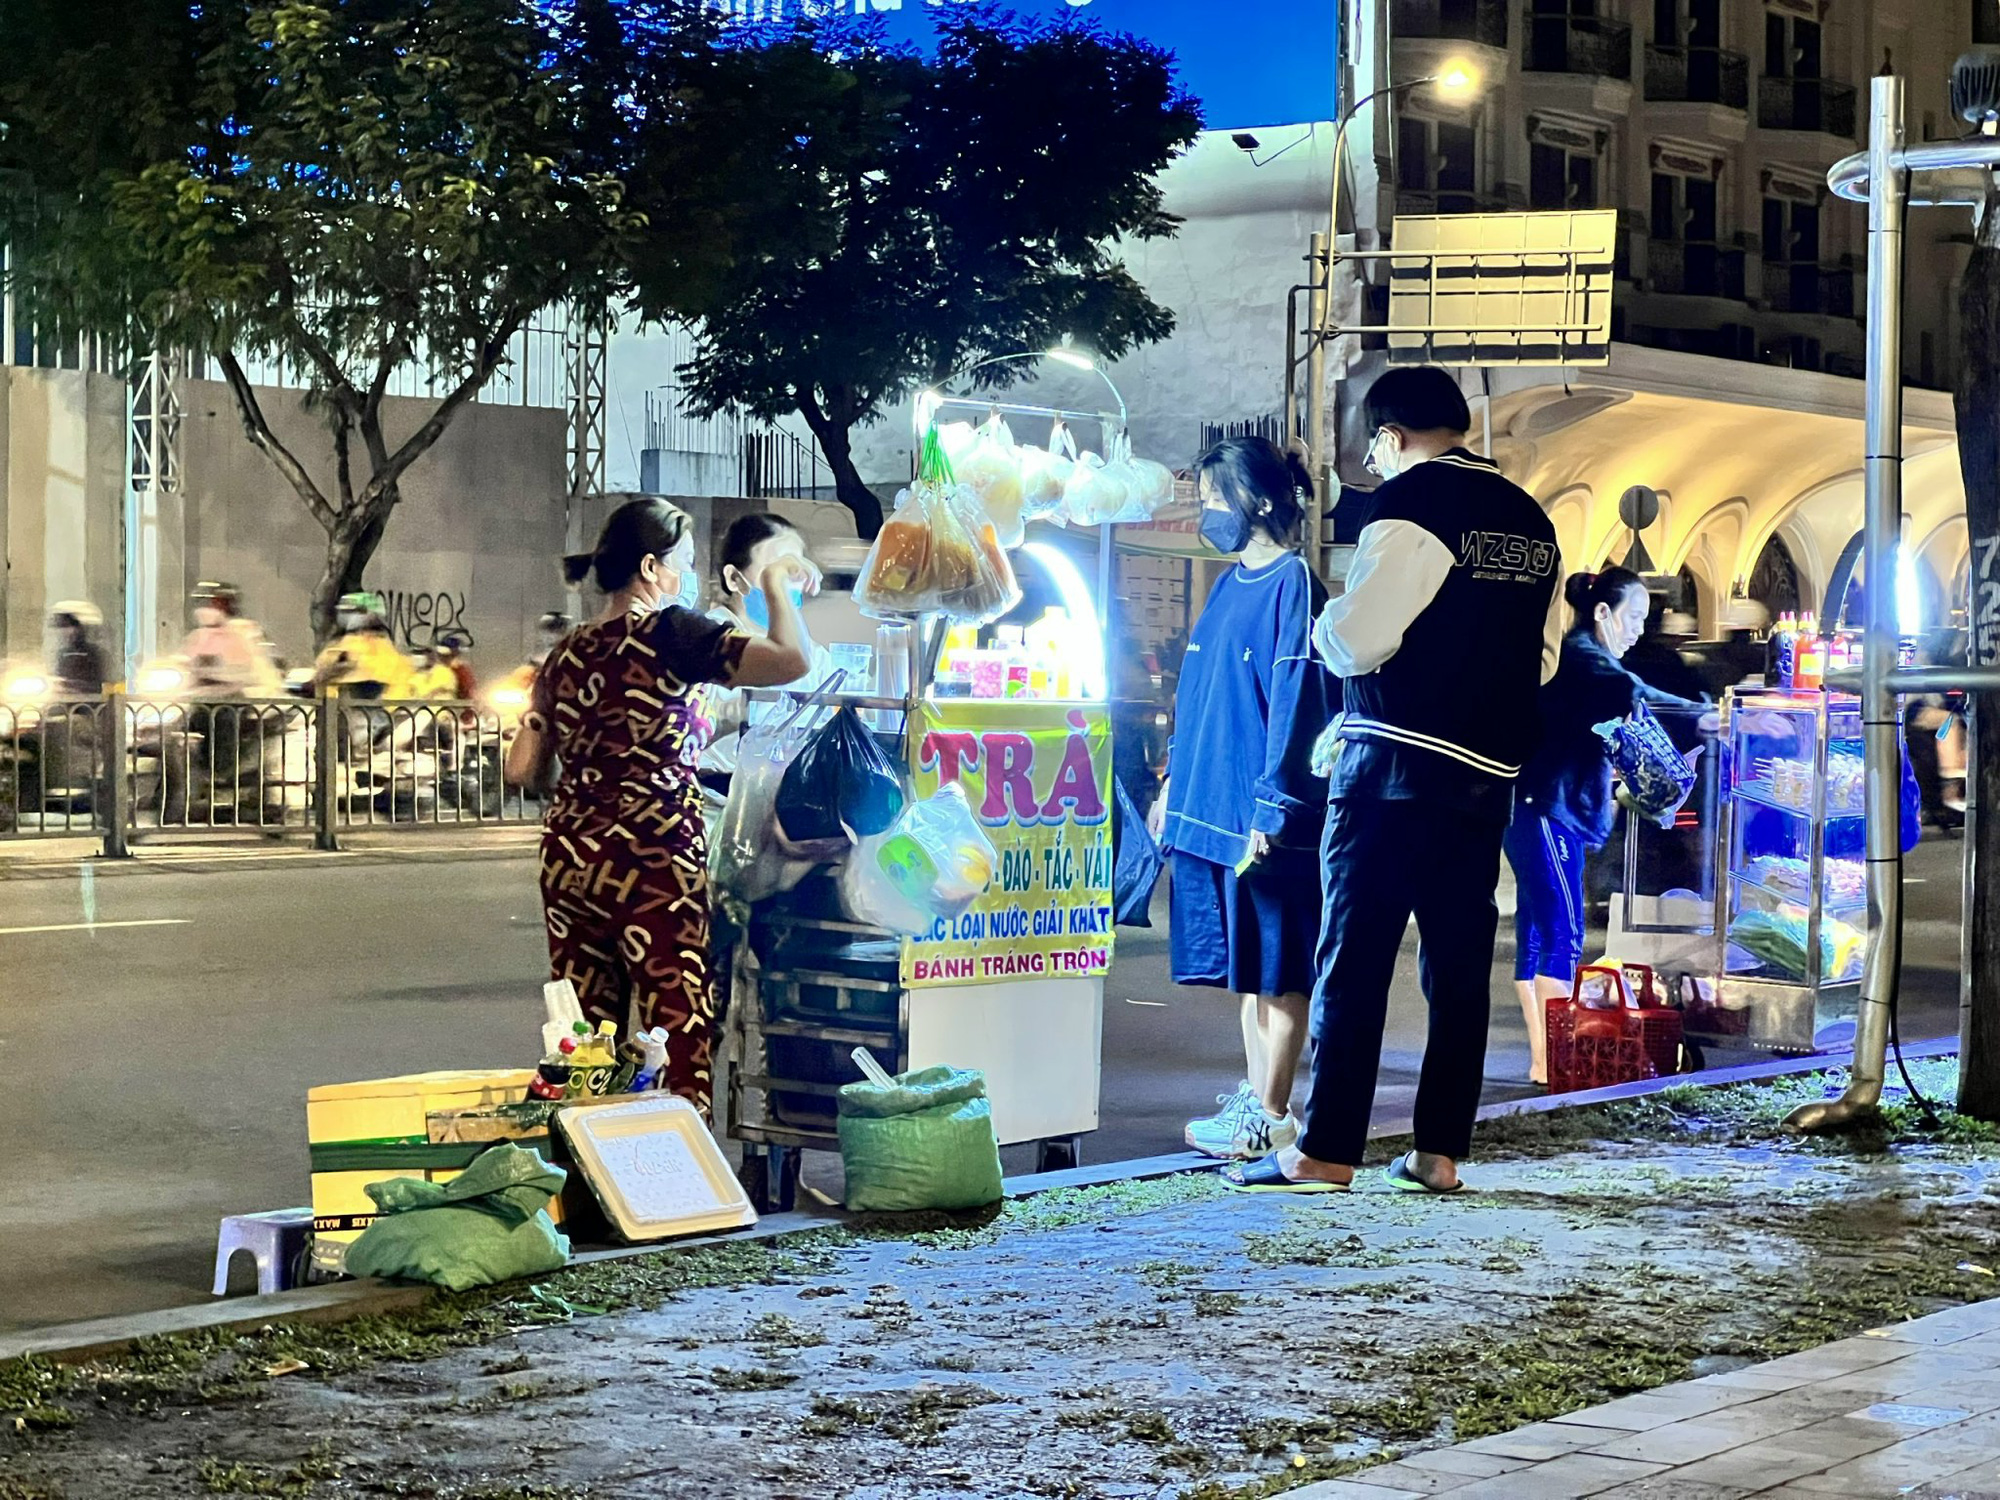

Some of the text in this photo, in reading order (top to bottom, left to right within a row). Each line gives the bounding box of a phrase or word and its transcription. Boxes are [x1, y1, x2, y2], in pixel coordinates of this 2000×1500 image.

[919, 708, 1108, 828] TRÀ
[1003, 837, 1032, 892] ĐÀO
[952, 912, 986, 947] LOẠI
[990, 904, 1028, 939] NƯỚC
[1033, 899, 1063, 937] GIẢI
[1069, 901, 1110, 935] KHÁT
[914, 946, 1106, 980] BÁNH TRÁNG TRỘN
